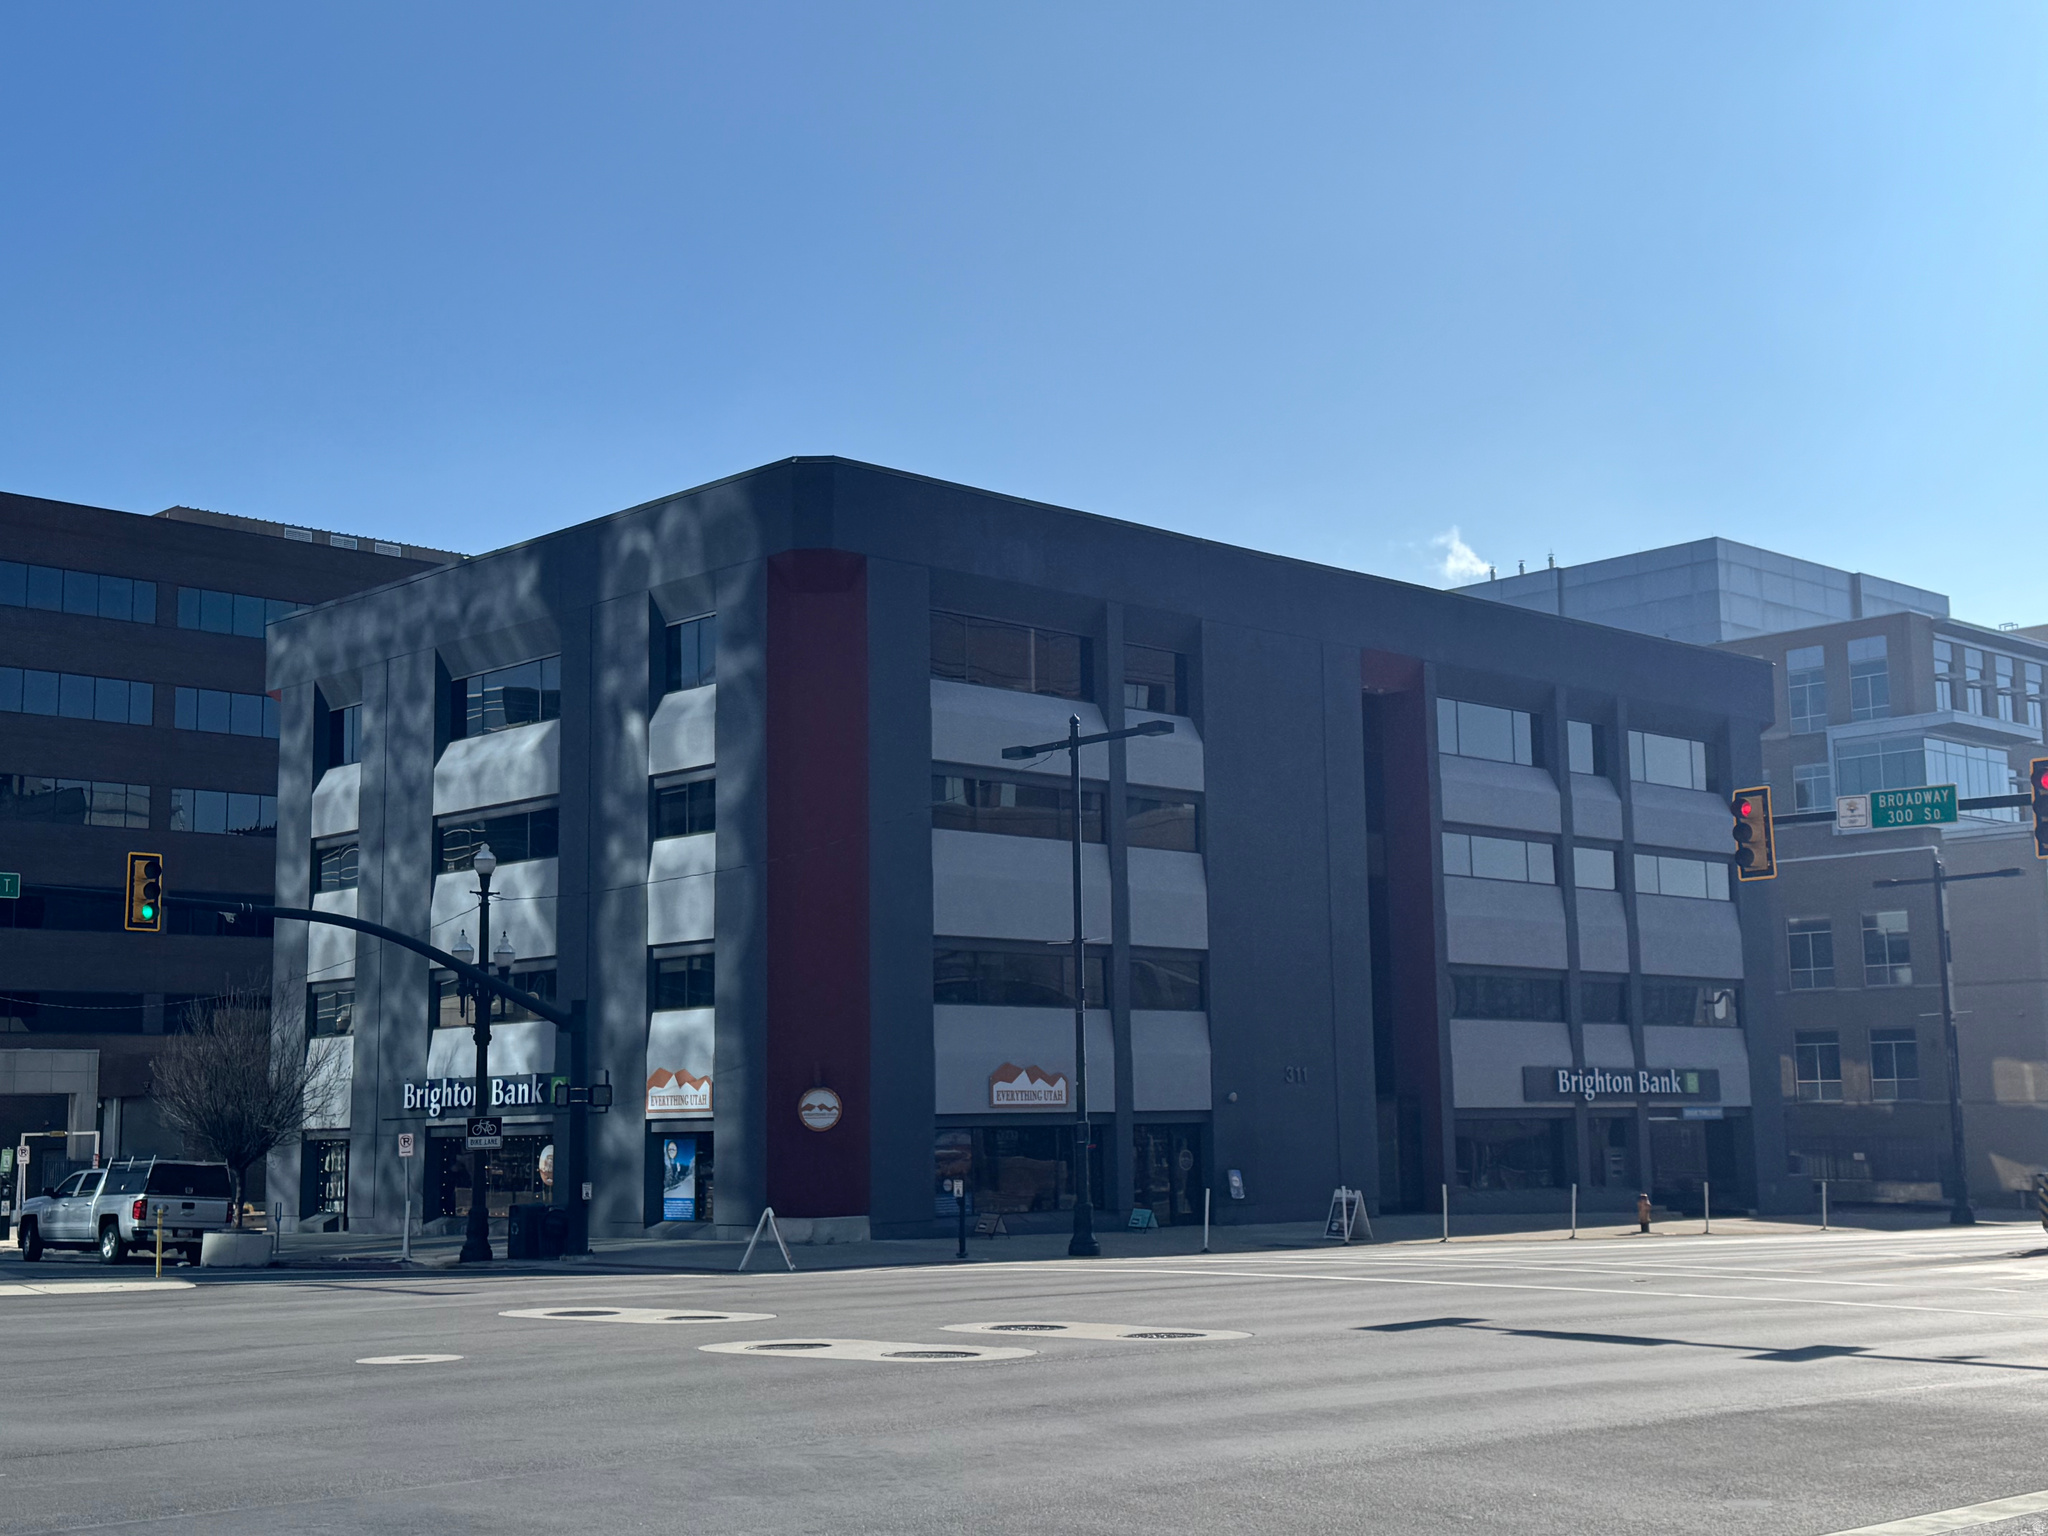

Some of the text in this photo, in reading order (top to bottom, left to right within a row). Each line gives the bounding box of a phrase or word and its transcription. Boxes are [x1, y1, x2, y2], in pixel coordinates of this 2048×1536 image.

[1879, 789, 1949, 808] BROADWAY
[1887, 809, 1913, 824] 300
[1285, 1065, 1308, 1083] 311
[490, 1073, 544, 1106] Bank
[1557, 1067, 1683, 1101] Brighton Bank
[650, 1094, 707, 1107] EVERYTHING UTAH
[996, 1089, 1063, 1102] EVERYTHING UTAH
